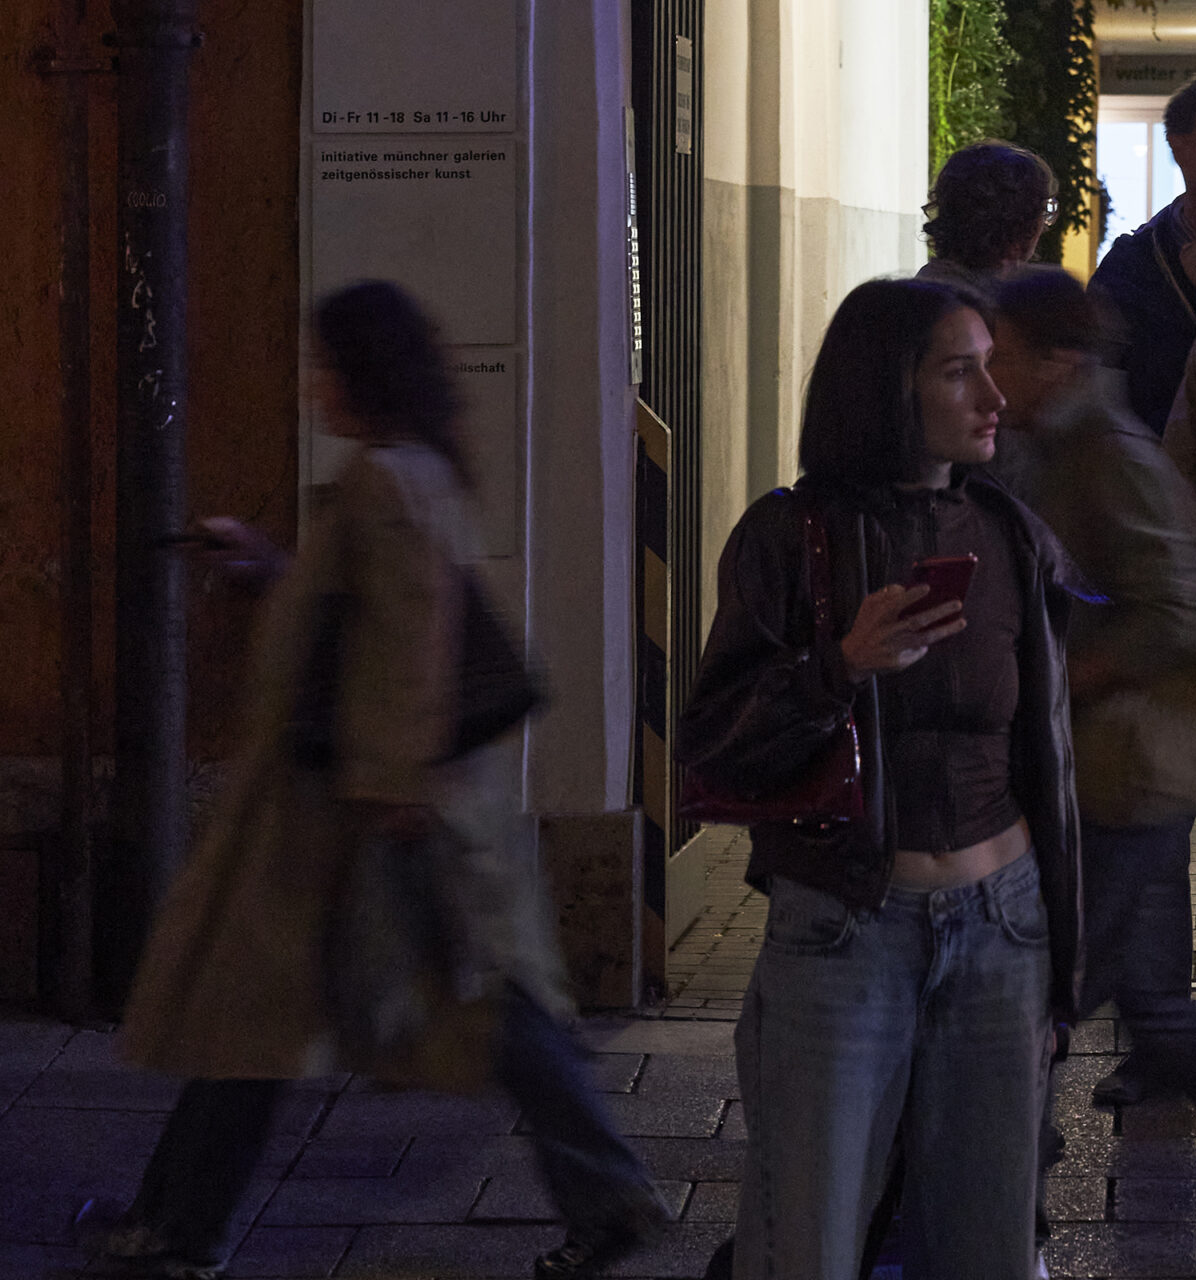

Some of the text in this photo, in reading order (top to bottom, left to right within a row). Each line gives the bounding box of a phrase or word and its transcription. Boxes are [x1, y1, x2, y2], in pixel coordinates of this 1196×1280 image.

[413, 111, 430, 123] Sa
[480, 111, 507, 123] Uhr
[321, 150, 506, 163] initiative münchner galerien
[321, 168, 471, 182] zeitgenössischer kunst
